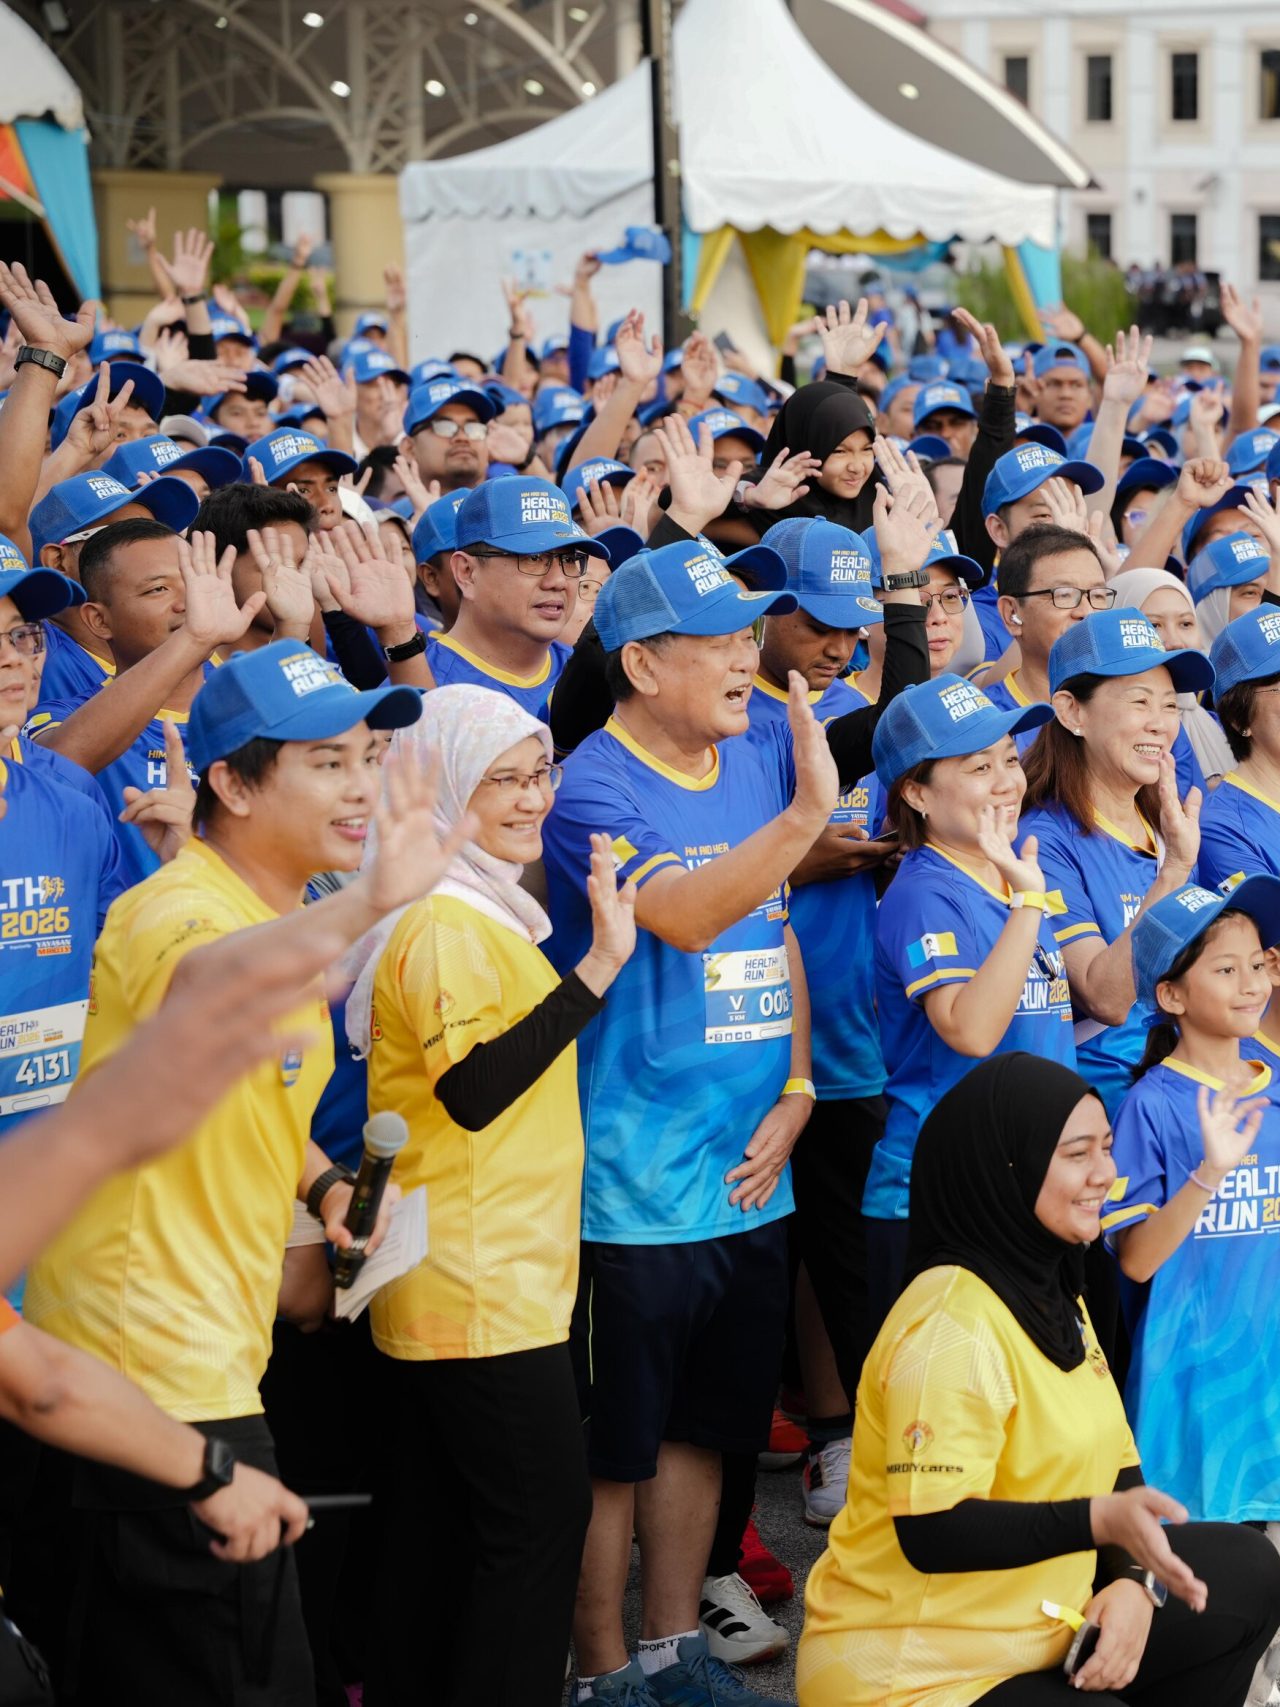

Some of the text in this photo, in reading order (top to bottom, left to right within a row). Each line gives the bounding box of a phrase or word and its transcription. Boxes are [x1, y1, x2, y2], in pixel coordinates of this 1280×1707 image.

[522, 510, 550, 522] RUN
[694, 572, 721, 595] RUN
[830, 569, 857, 582] RUN
[1123, 636, 1151, 648] RUN
[291, 670, 329, 698] RUN
[949, 702, 977, 723] RUN
[1, 907, 70, 939] 2026
[744, 969, 764, 981] RUN
[729, 995, 744, 1011] V
[15, 1049, 72, 1085] 4131
[1194, 1199, 1259, 1234] RUN
